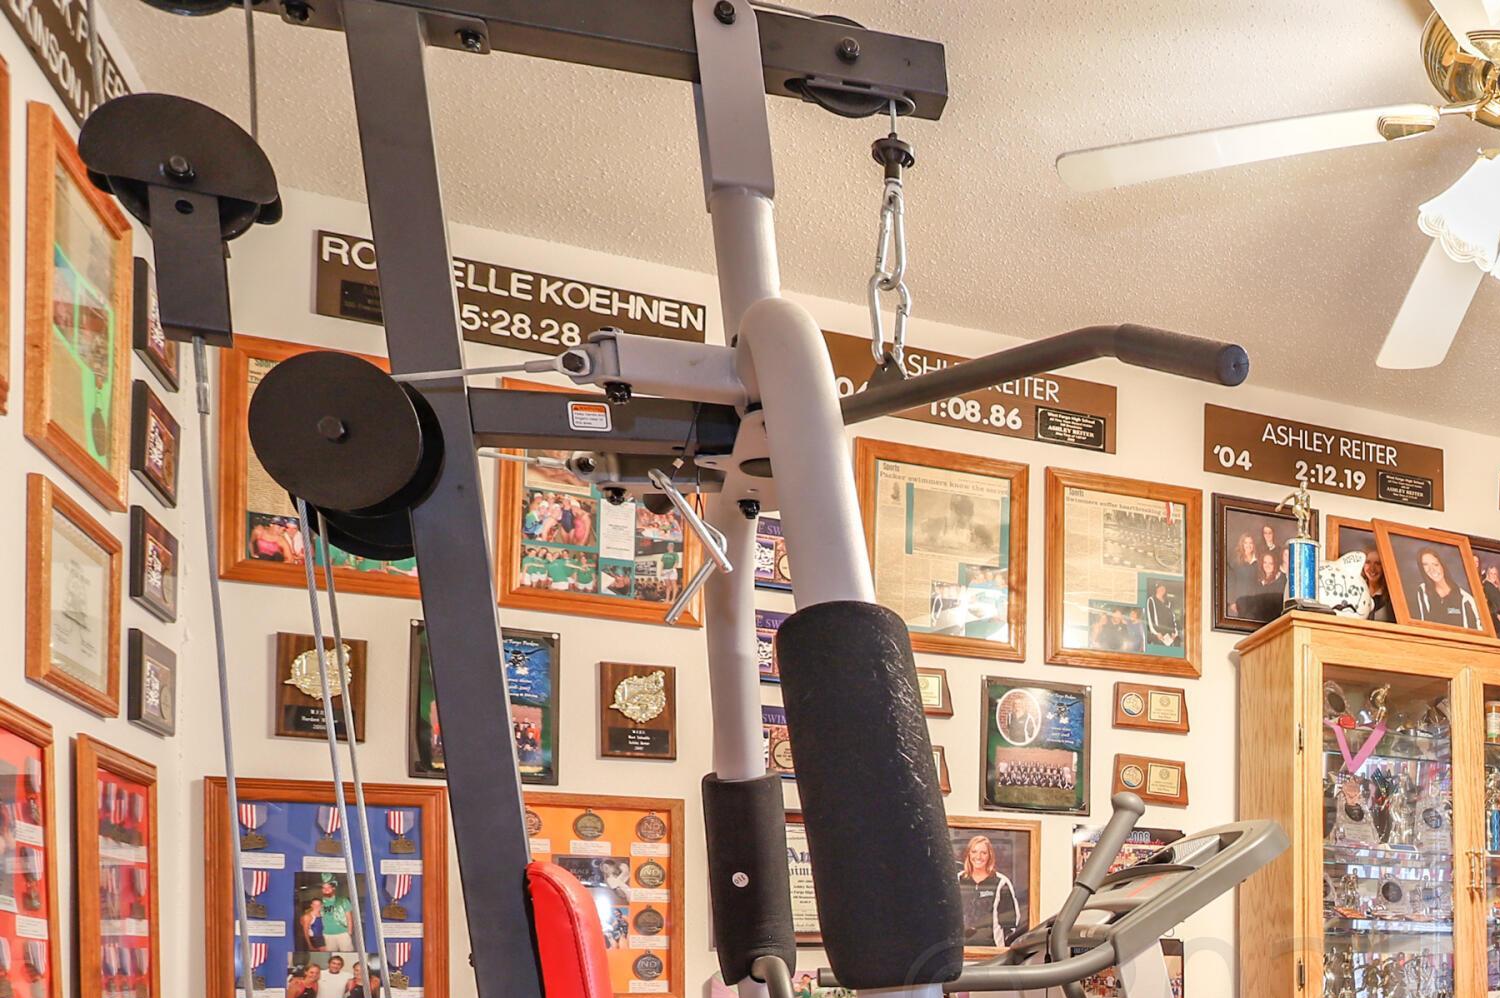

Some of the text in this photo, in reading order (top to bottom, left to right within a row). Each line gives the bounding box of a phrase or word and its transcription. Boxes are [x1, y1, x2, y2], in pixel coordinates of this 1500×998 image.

[539, 278, 704, 331] KOEHNEN
[930, 398, 1022, 430] 1:08.86
[1262, 423, 1398, 467] ASHLEY REITER
[908, 475, 948, 488] swimmers
[1295, 460, 1367, 491] 2:12.19
